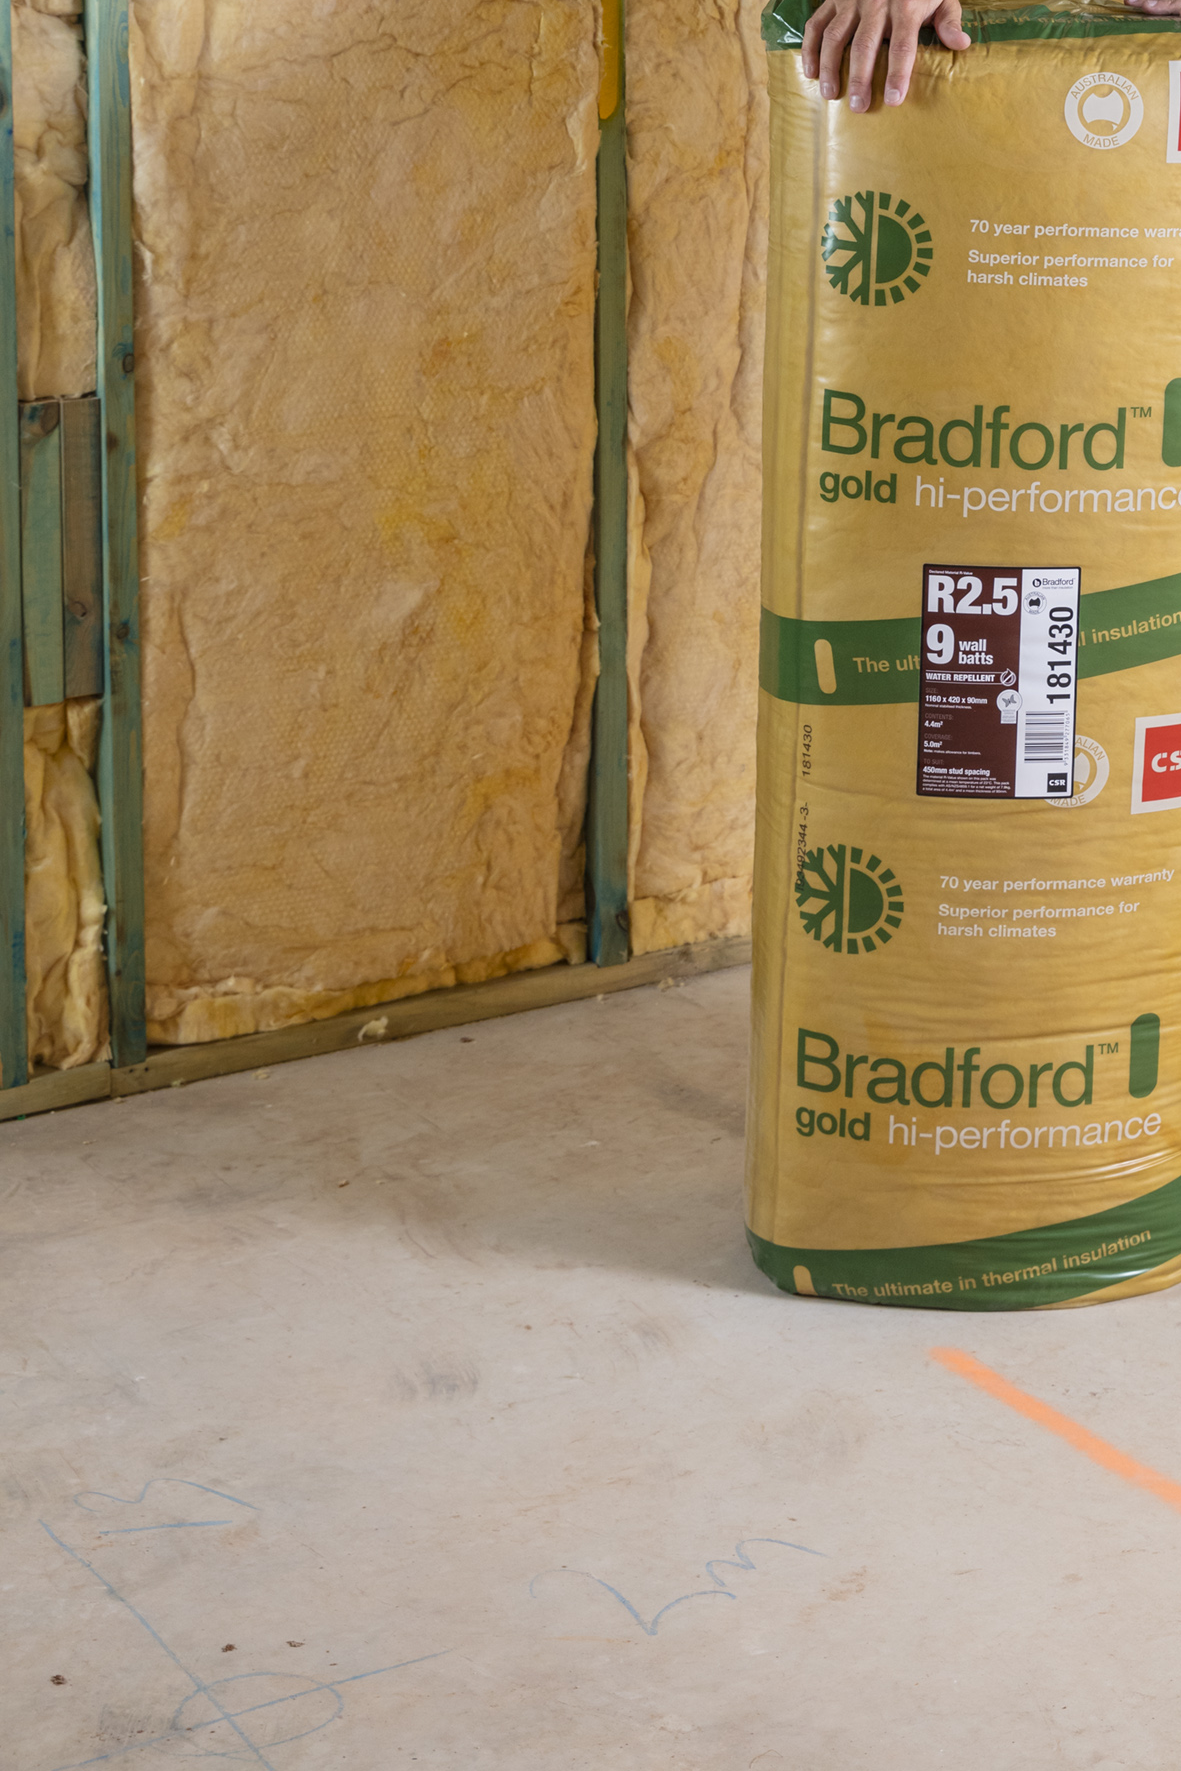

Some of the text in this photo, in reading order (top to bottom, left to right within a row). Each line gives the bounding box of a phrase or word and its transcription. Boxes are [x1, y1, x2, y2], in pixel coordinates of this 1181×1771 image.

[1070, 74, 1139, 100] AUSTRALIAN
[1083, 133, 1120, 148] MADE
[970, 219, 989, 233] 70
[994, 223, 1030, 237] year
[1034, 223, 1139, 238] performance
[968, 249, 1174, 269] Superior performance for
[967, 269, 1088, 287] harsh climates
[821, 389, 1127, 470] Bradford
[819, 470, 897, 504] gold
[927, 575, 1019, 616] R2.5
[926, 624, 955, 665] 9
[959, 639, 987, 651] wall
[852, 656, 890, 673] The
[958, 652, 993, 665] batts
[1046, 607, 1074, 704] 181430
[926, 672, 995, 683] WATER REPELLENT
[925, 695, 941, 703] 1160
[948, 696, 960, 704] 420
[802, 724, 813, 777] 181430
[1075, 737, 1105, 761] ALIAN
[923, 766, 947, 774] 450mm
[965, 768, 990, 777] spacing
[1051, 794, 1086, 807] MADE
[940, 868, 1175, 893] 70 year performance warranty
[938, 901, 1140, 921] Superior performance for
[937, 923, 1057, 938] harsh climates
[796, 1027, 1095, 1110] Bradford
[795, 1107, 1163, 1155] gold hi-performance
[832, 1229, 1152, 1297] The ultimate in thermal insulation
